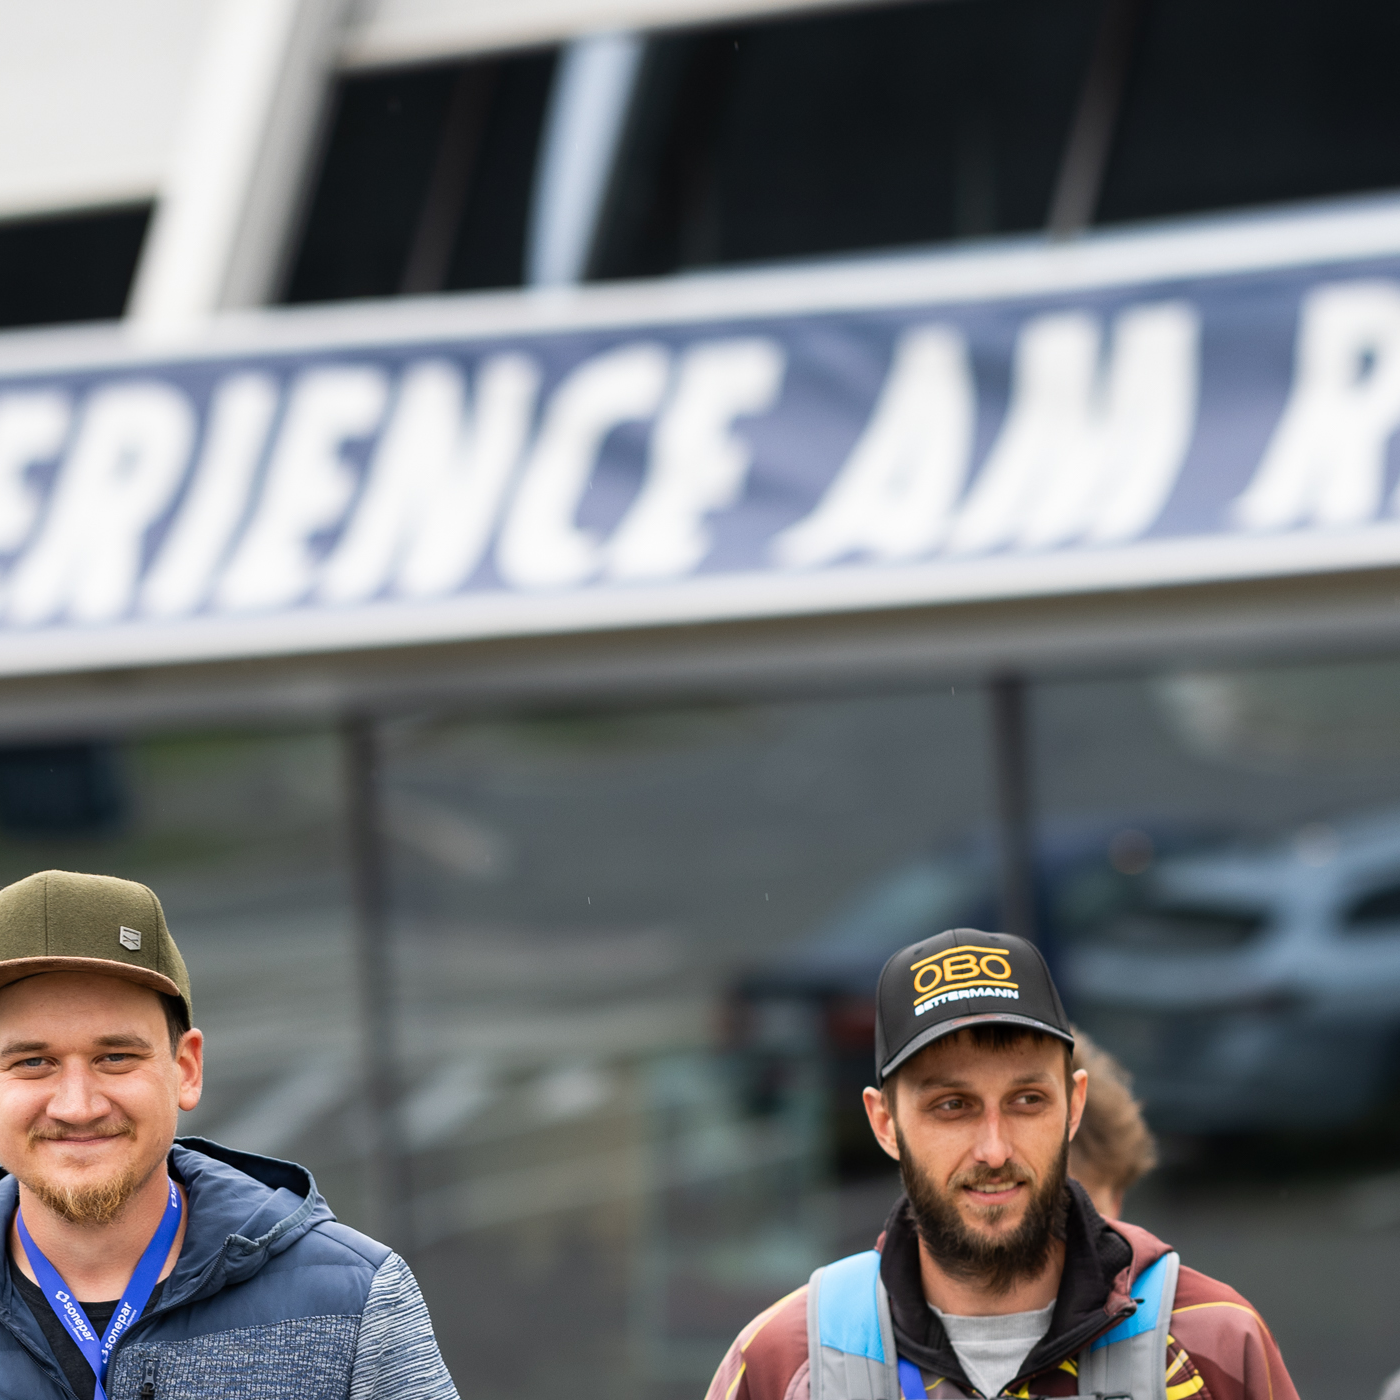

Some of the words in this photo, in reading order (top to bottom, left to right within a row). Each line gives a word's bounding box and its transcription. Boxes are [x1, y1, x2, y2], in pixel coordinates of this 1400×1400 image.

[771, 300, 1198, 569] AM
[914, 954, 1012, 994] OBO
[914, 987, 1019, 1017] BETTERMANN
[63, 1301, 95, 1342] sonepar
[105, 1301, 132, 1350] sonepar
